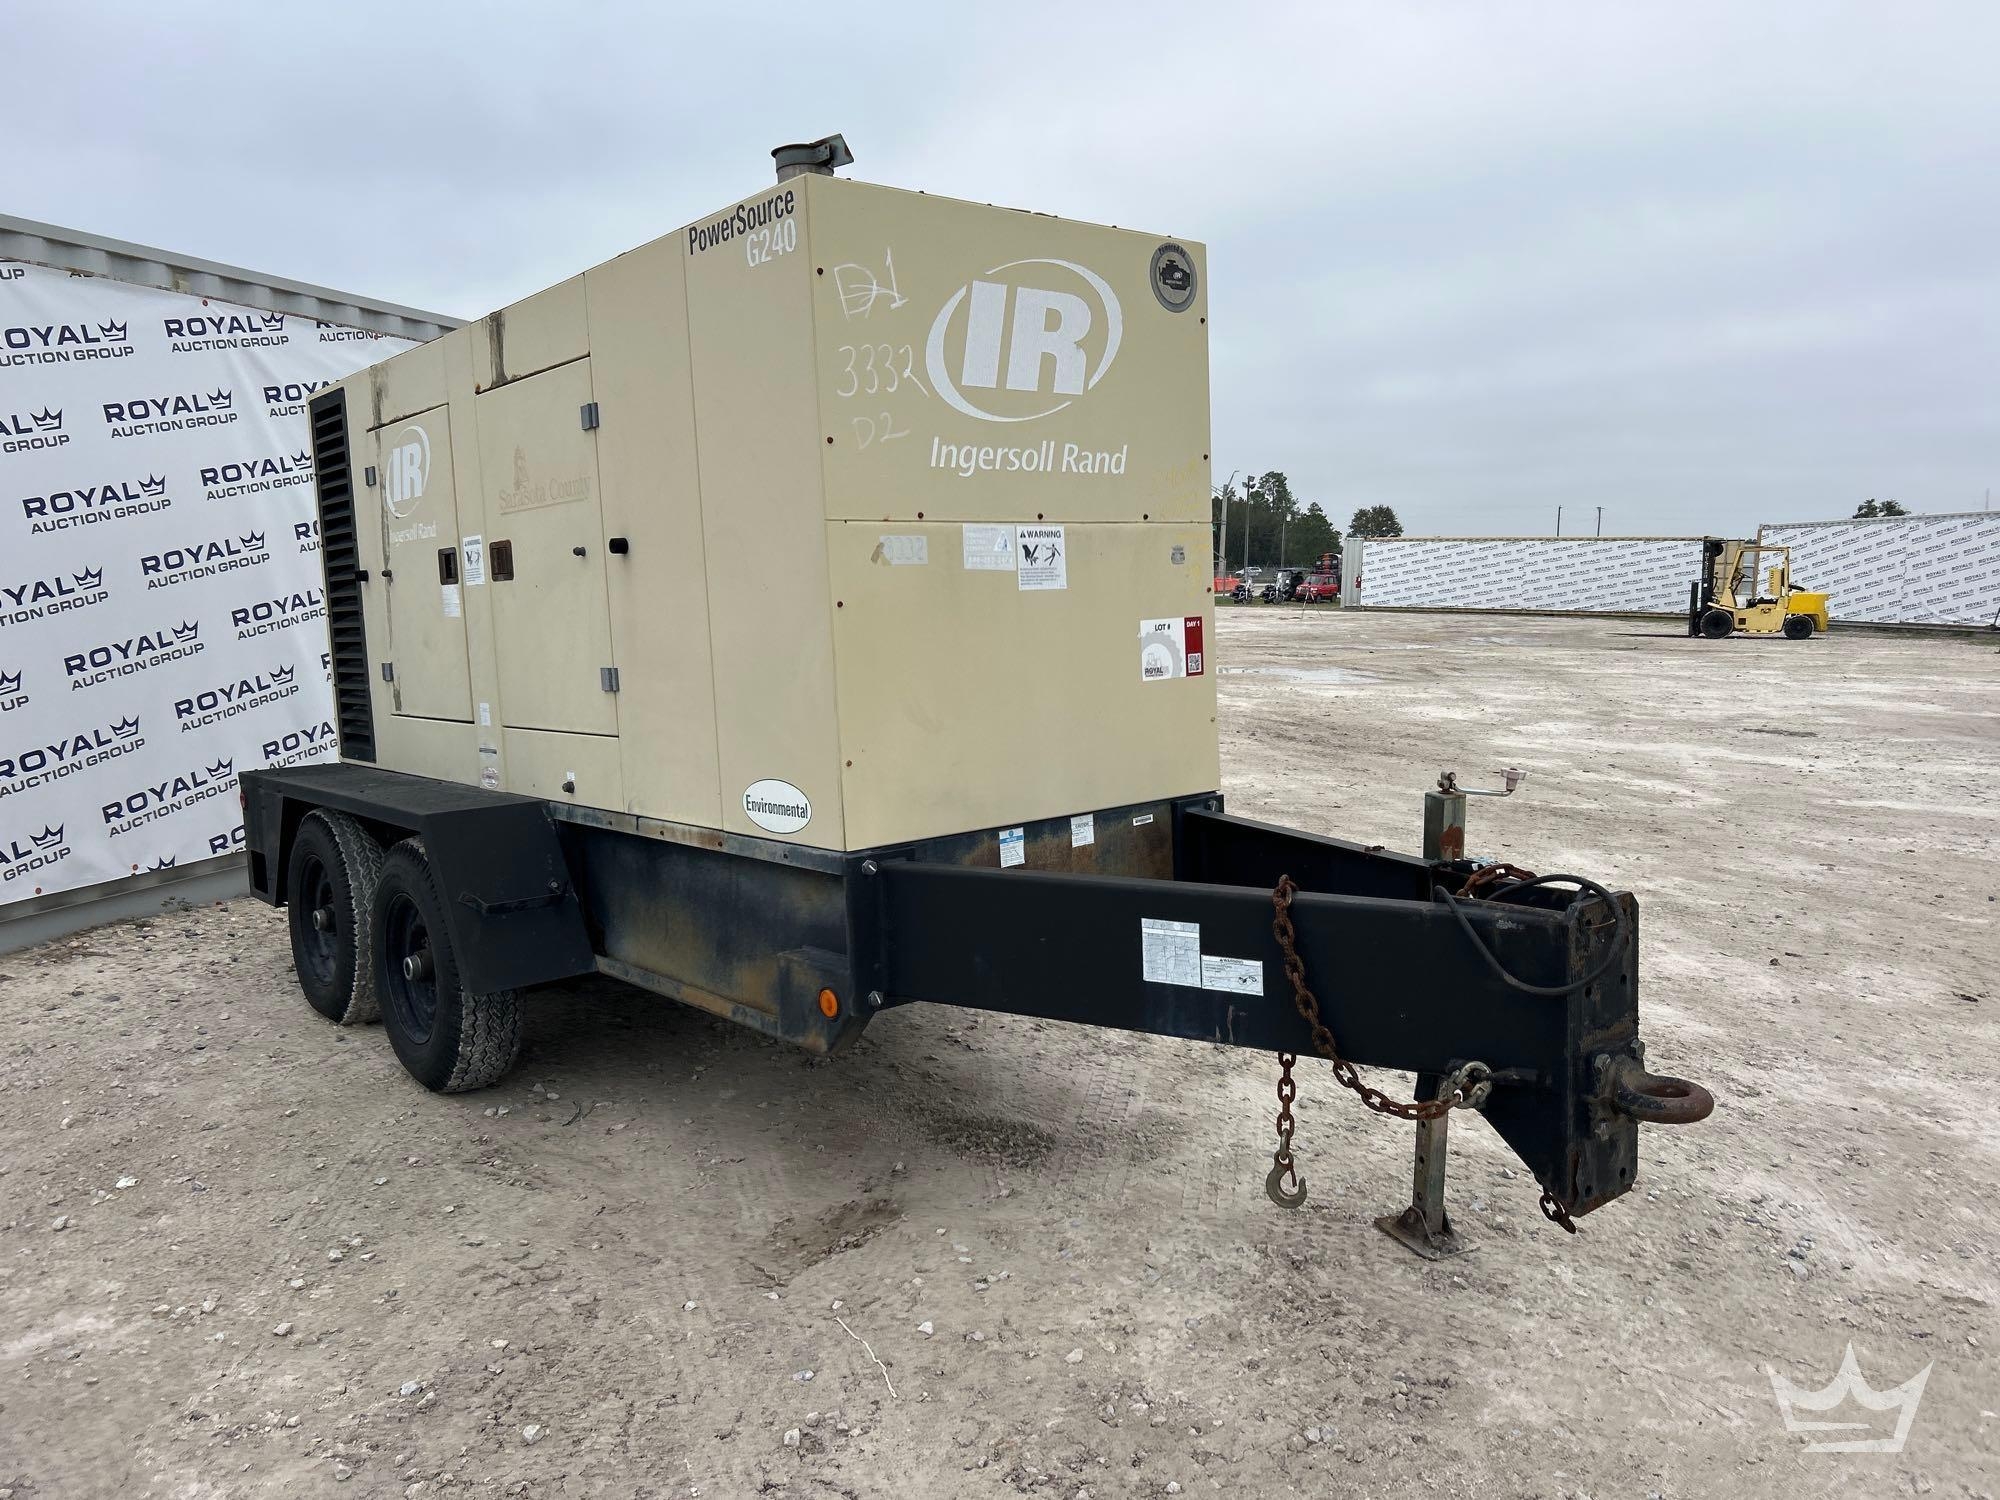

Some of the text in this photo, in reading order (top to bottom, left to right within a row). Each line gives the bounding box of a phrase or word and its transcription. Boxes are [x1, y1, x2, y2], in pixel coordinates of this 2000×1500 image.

[689, 190, 795, 255] PowerSource
[747, 218, 796, 267] G240
[0, 324, 101, 349] OYAL
[163, 315, 262, 338] ROYAL
[171, 335, 289, 353] AUCTION GROUP
[319, 331, 374, 343] AUCTION
[962, 280, 1091, 395] IR
[0, 346, 134, 367] UCTION GROUP
[103, 394, 210, 423] ROYAL
[111, 413, 238, 439] AUCTION GROUP
[269, 405, 306, 418] AUCT
[2, 435, 70, 453] GROUP
[852, 412, 910, 450] D2
[200, 456, 293, 487] ROYAL
[392, 443, 422, 502] IR
[930, 436, 1129, 477] Ingersoll Rand
[22, 482, 141, 519] ROYAL
[206, 473, 315, 501] AUCTION GROUP
[31, 499, 172, 535] AUCTION GROUP
[1027, 530, 1062, 539] WARNING
[141, 538, 241, 576] ROYAL
[147, 553, 271, 590] AUCTION GROUP
[0, 577, 75, 608] YAL
[0, 591, 109, 627] TION GROUP
[231, 589, 321, 627] ROYAL
[237, 607, 326, 640] AUCTION GRO
[1155, 624, 1166, 632] LOT
[64, 631, 174, 676] ROYAL
[72, 642, 205, 691] AUCTION GROUP
[1144, 667, 1164, 676] ROYAL
[174, 675, 271, 719] ROYAL
[181, 685, 299, 733] AUCTION GROUP
[262, 721, 335, 760] ROYA
[269, 741, 329, 769] AUCTION
[0, 738, 145, 798] AUCTION GROUP
[102, 771, 208, 824] ROYAL
[109, 779, 239, 838] AUCTION GROUP
[745, 794, 808, 819] Environmental
[3, 847, 71, 881] GROUP
